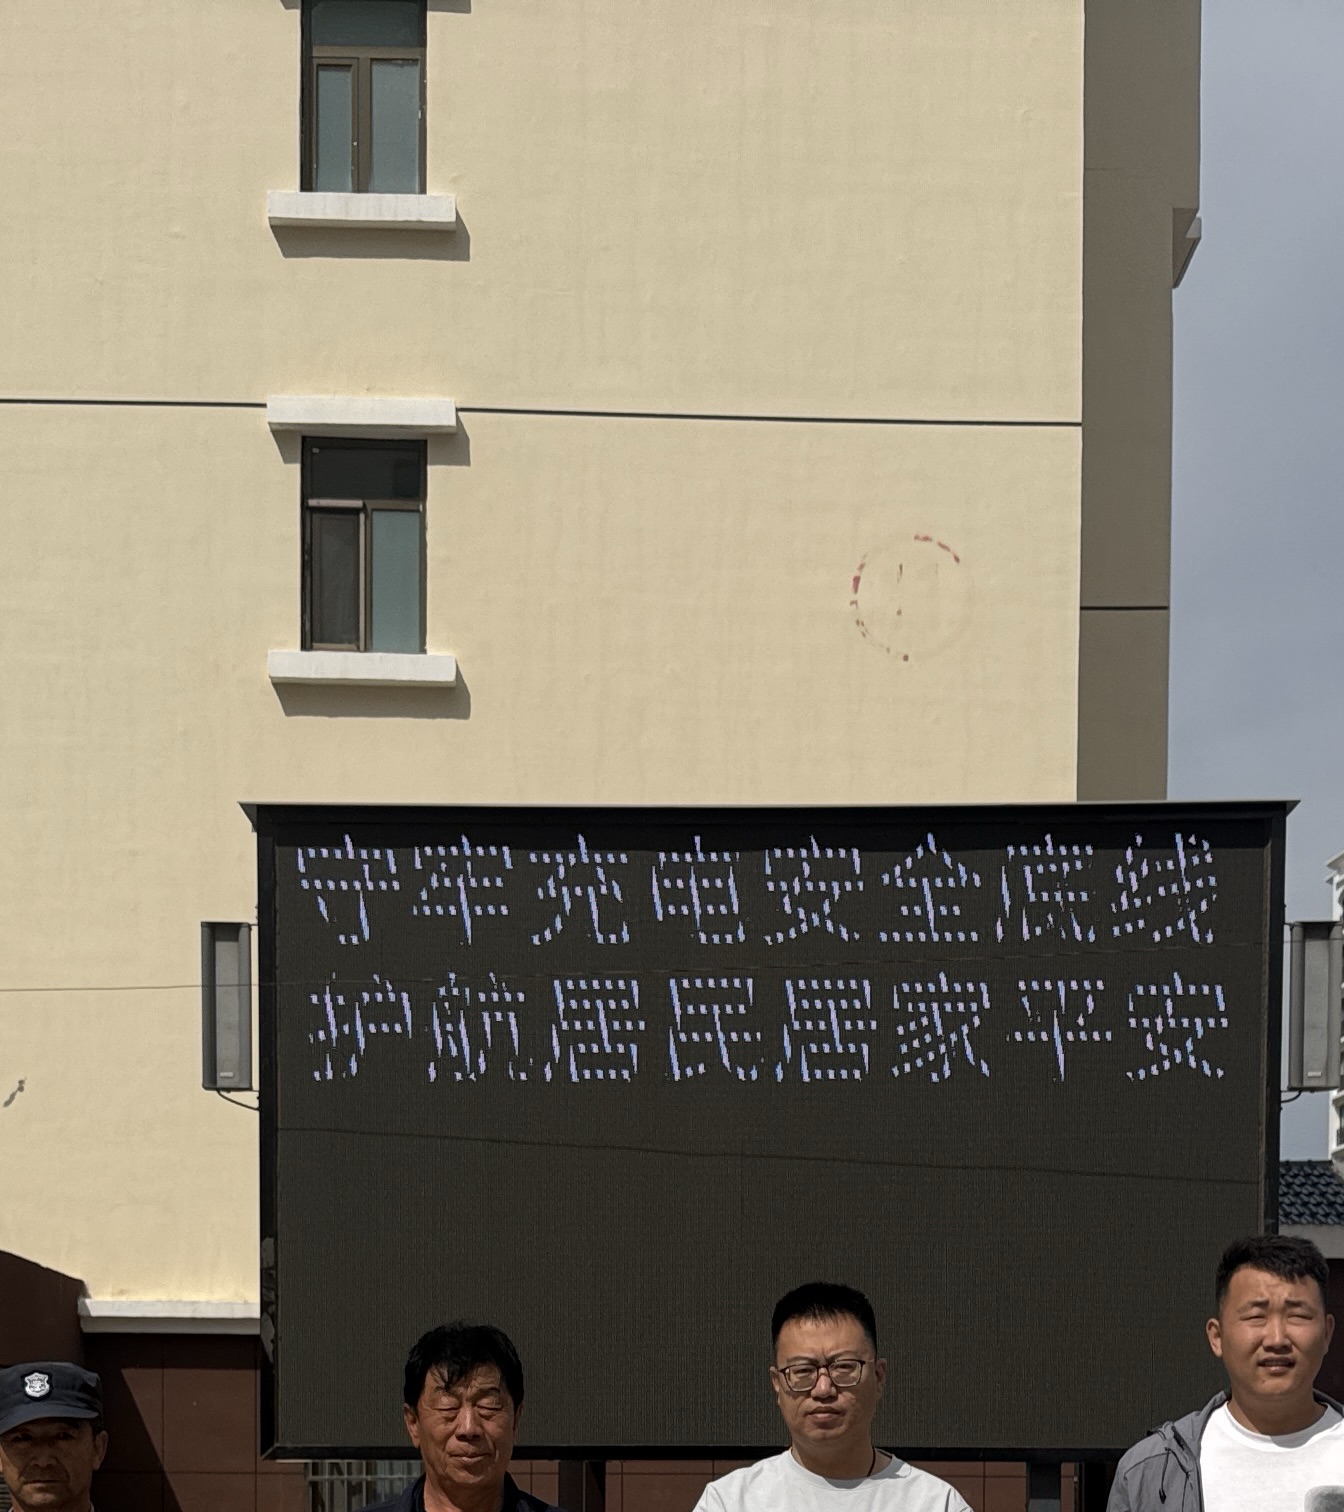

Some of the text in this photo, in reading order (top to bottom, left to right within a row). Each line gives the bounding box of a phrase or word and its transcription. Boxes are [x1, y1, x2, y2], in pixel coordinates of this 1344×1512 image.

[297, 832, 1217, 946] 守牢充电安全底线
[309, 971, 1229, 1083] 护航居民居家平安
